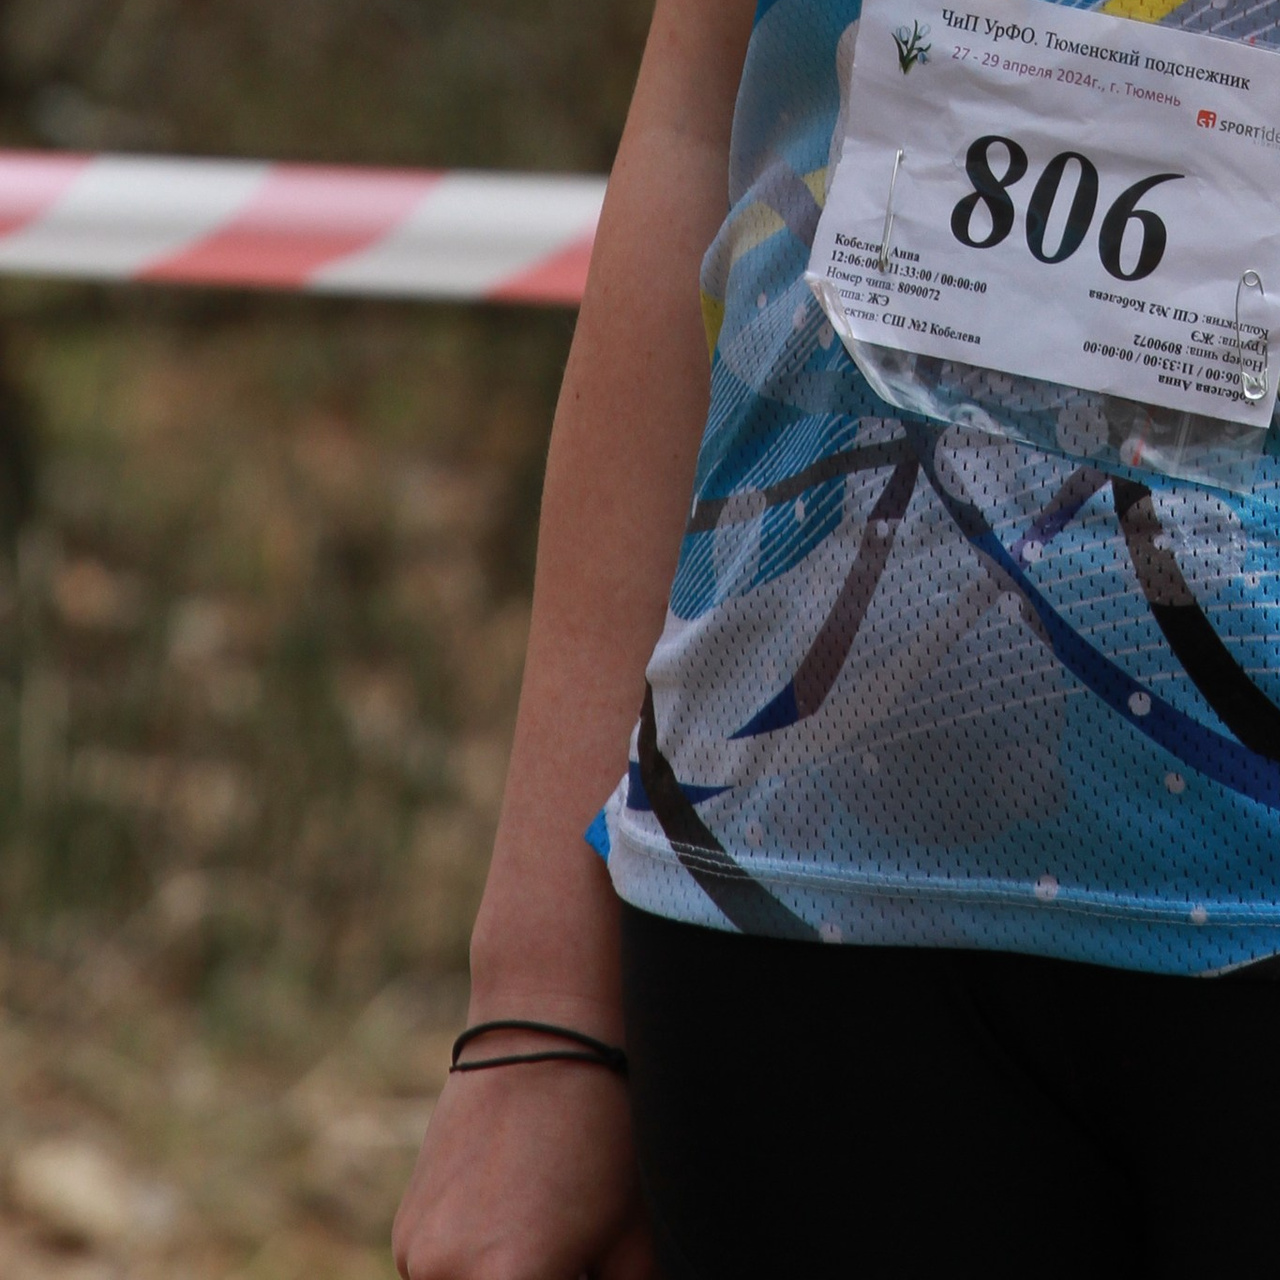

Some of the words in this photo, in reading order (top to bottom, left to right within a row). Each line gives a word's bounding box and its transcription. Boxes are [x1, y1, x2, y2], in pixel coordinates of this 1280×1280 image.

[942, 8, 980, 32] ЧиП
[984, 18, 1039, 46] УрФО.
[1045, 31, 1141, 67] Тюменский
[1144, 56, 1251, 91] подснежник
[952, 46, 971, 61] 27
[981, 52, 1000, 68] 29
[1003, 58, 1053, 80] апреля
[1124, 82, 1181, 107] Тюмень
[951, 135, 1186, 282] 806
[834, 233, 885, 256] Кобелев
[890, 246, 920, 262] Анна
[831, 250, 879, 270] 12:06:00
[888, 262, 932, 282] 11:33:00
[940, 274, 987, 294] 00:00:00
[826, 266, 863, 286] Номер
[866, 277, 895, 292] чипа:
[897, 282, 941, 302] 8090072
[867, 292, 890, 307] ЖЭ
[1088, 289, 1146, 312] Кобелева
[1172, 308, 1198, 324] СШ
[882, 312, 905, 328] СШ
[930, 323, 981, 345] Кобелева
[1191, 330, 1215, 345] ЖЭ
[1083, 340, 1133, 362] 00:00:00
[1133, 334, 1182, 355] 8090072
[1186, 345, 1218, 361] чипа:
[1143, 354, 1194, 375] 11:33:00
[1158, 374, 1192, 391] Анна
